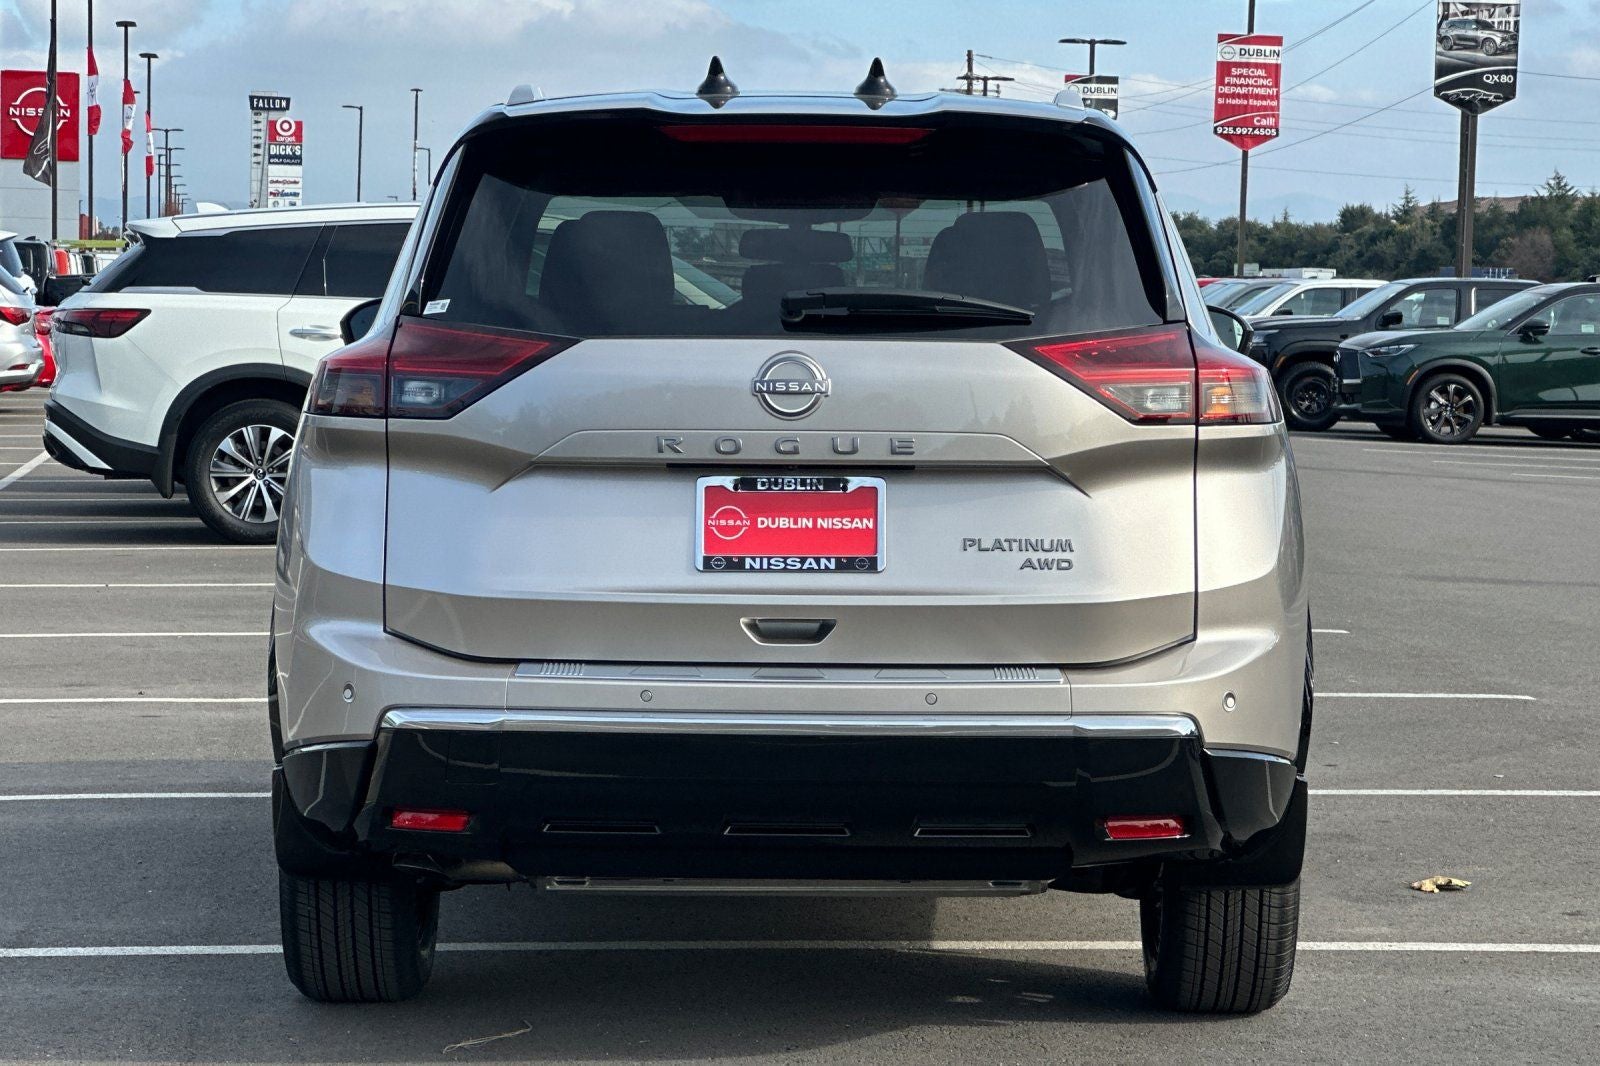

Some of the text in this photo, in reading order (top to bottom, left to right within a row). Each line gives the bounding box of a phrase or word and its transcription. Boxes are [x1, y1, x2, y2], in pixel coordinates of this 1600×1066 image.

[1239, 47, 1281, 58] DUBLIN
[1231, 67, 1267, 77] SPECIAL
[1224, 77, 1273, 86] FINANCING
[1483, 74, 1514, 84] QX80
[1082, 86, 1117, 95] DUBLIN
[1218, 86, 1278, 96] DEPARTMENT
[253, 98, 286, 108] FALLON
[1249, 98, 1278, 107] Español
[9, 106, 71, 118] NISSN
[1216, 126, 1277, 136] 925.997.4505
[269, 145, 301, 155] DICK'S
[755, 381, 828, 392] NISSAN
[656, 435, 917, 456] ROGUE
[756, 477, 825, 491] DUBLIN
[707, 519, 751, 527] NISSAN
[757, 517, 873, 530] DUBLIN NISSAN
[962, 537, 1075, 553] PLATINUM
[744, 557, 836, 570] NISSAN
[1020, 557, 1074, 571] AWD
